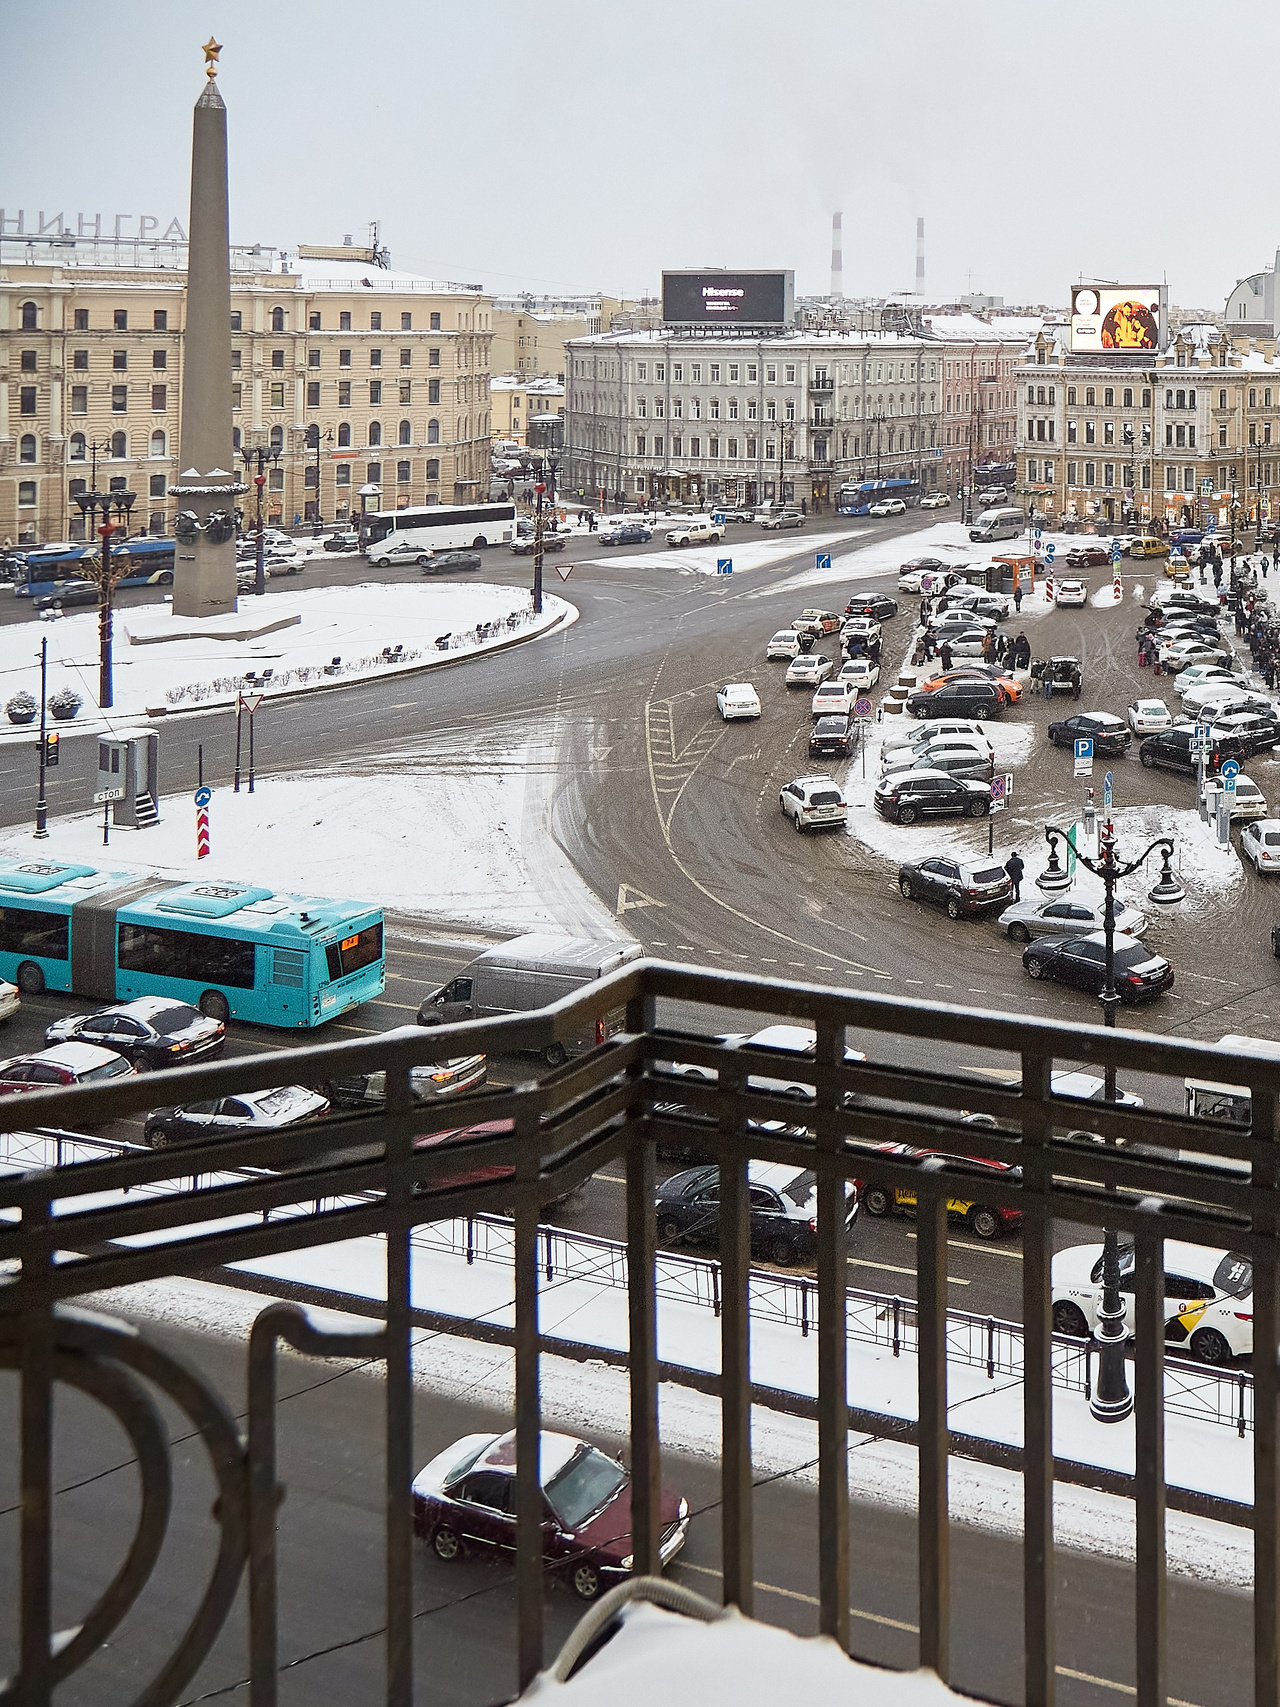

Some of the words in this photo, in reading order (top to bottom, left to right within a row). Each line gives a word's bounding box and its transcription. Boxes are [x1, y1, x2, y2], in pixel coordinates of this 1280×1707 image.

[702, 287, 744, 297] Hisense
[1079, 741, 1090, 756] P
[98, 789, 120, 800] СТОП
